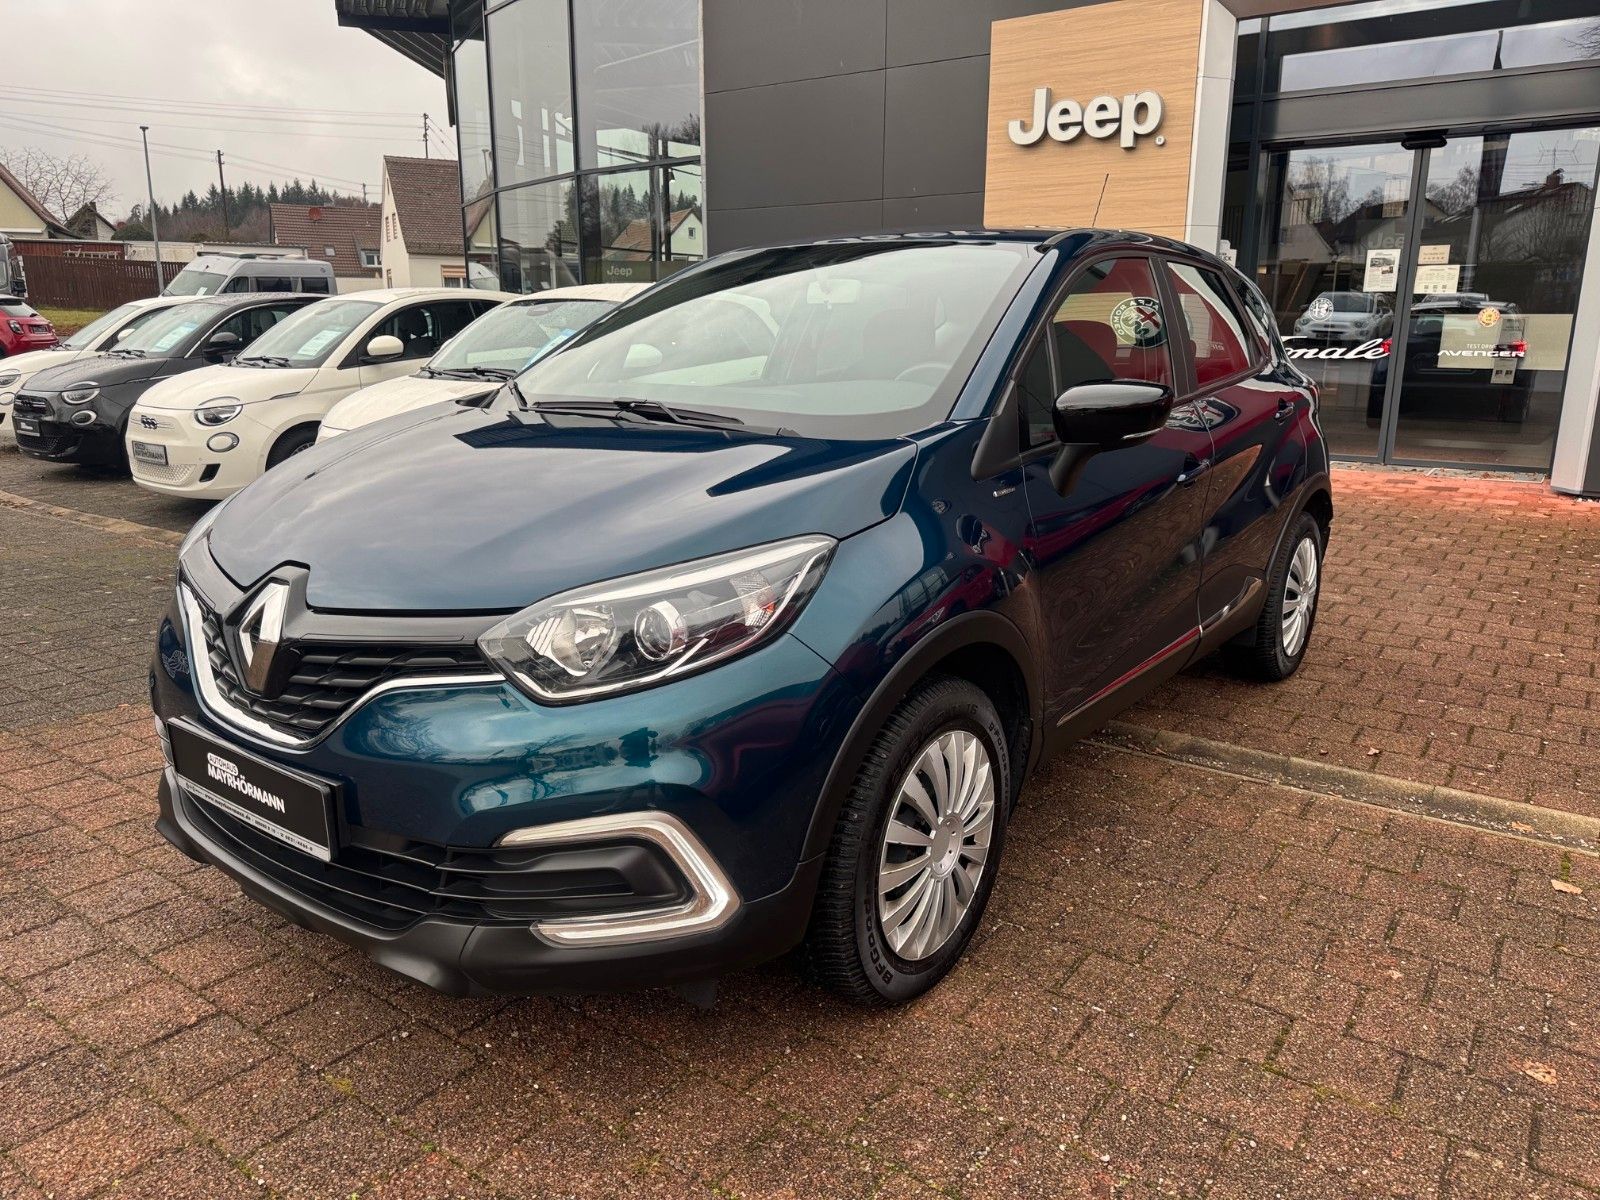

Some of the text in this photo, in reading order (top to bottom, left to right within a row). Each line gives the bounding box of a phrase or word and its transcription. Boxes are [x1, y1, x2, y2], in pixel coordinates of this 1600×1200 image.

[1008, 87, 1165, 149] Jeep
[1368, 232, 1405, 249] Jee
[606, 265, 633, 277] Jeep
[1437, 349, 1525, 358] AVENGER
[209, 754, 238, 775] AUTOHAUS
[207, 764, 286, 814] MAYRHÖRMANN
